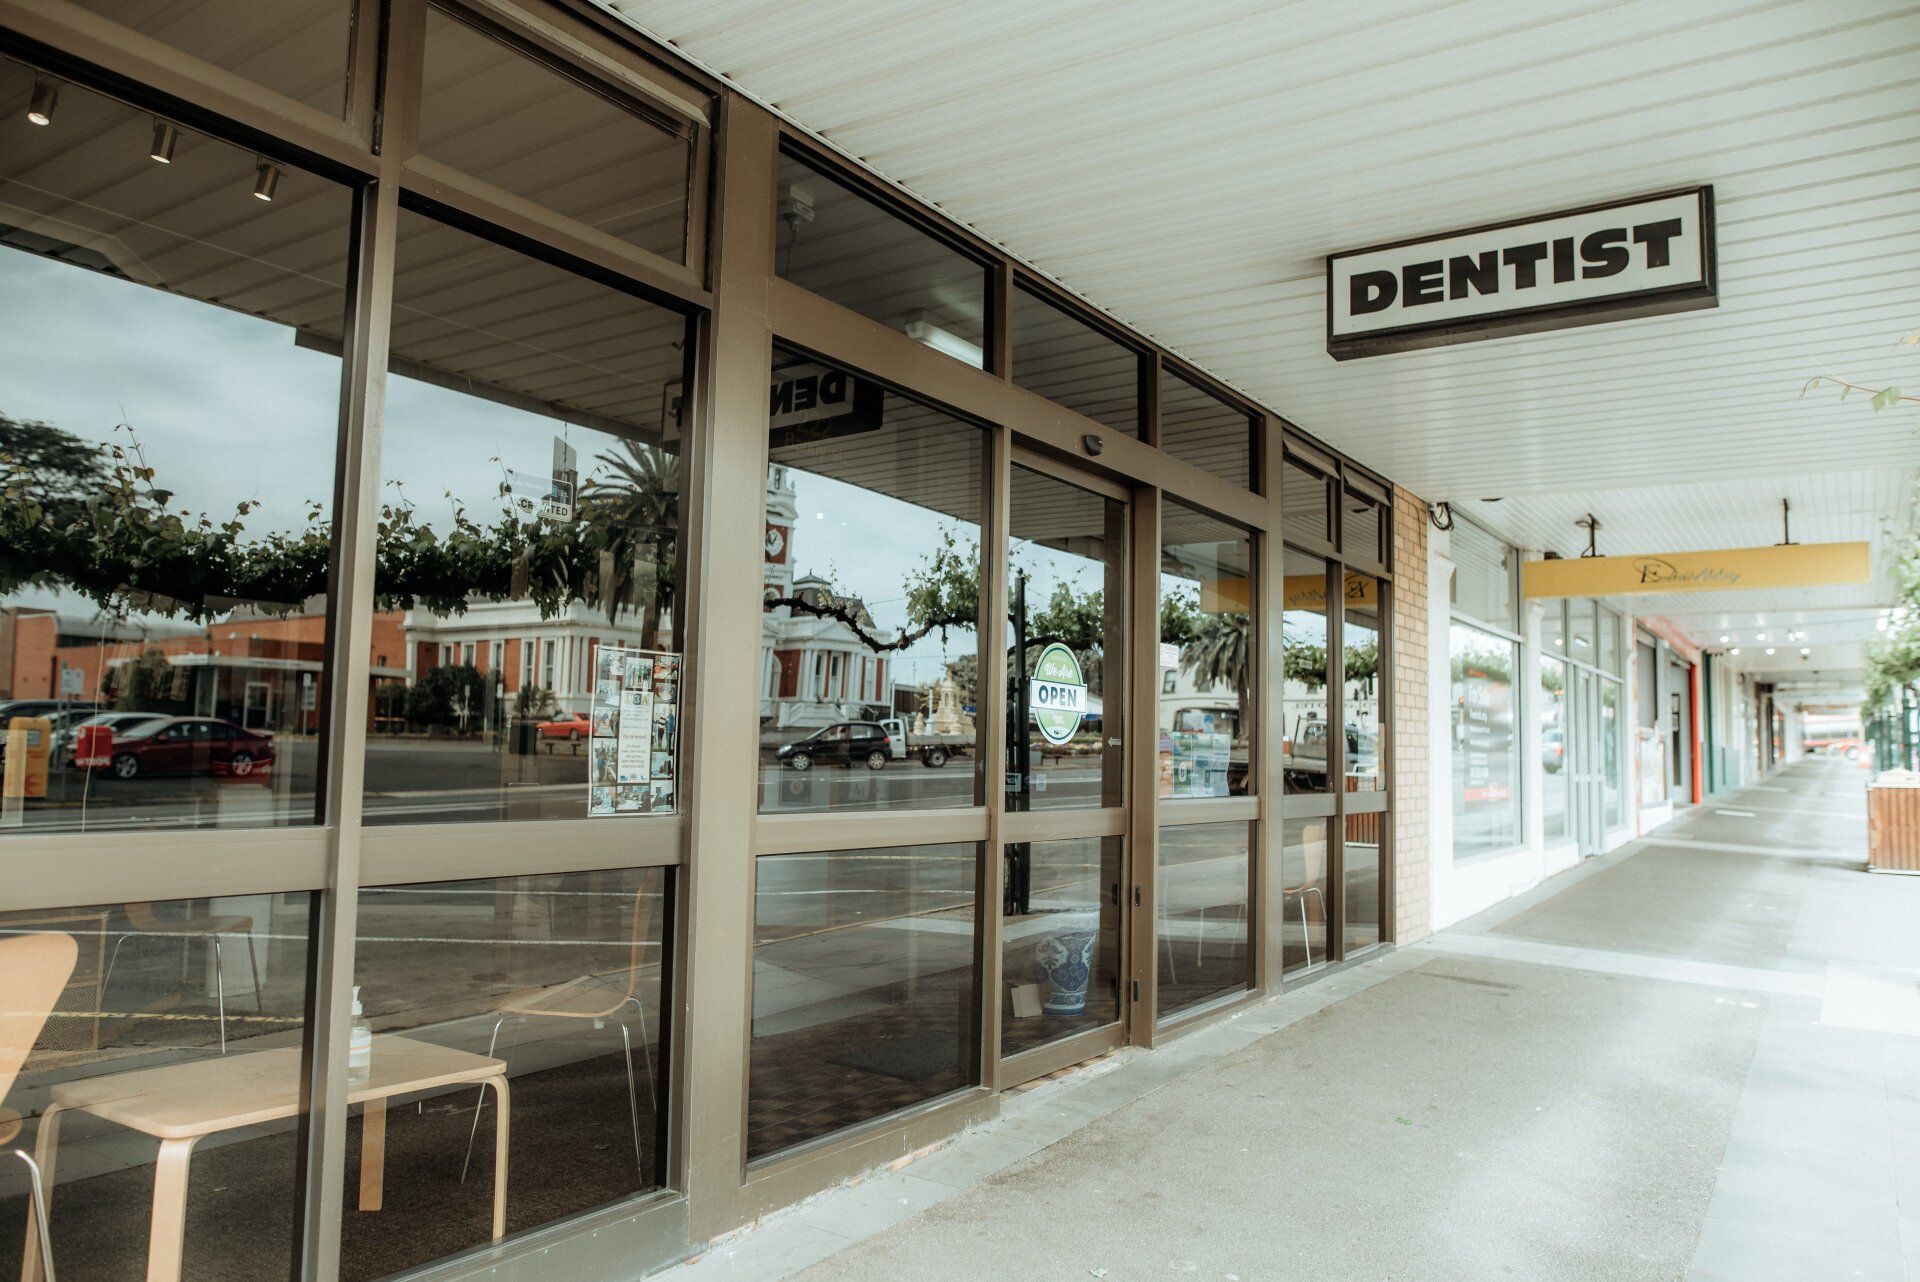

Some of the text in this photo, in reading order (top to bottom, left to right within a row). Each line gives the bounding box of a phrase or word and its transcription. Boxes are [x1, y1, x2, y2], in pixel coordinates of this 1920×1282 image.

[1350, 217, 1682, 317] DENTIST
[1044, 662, 1074, 680] We Are
[1039, 685, 1077, 707] OPEN
